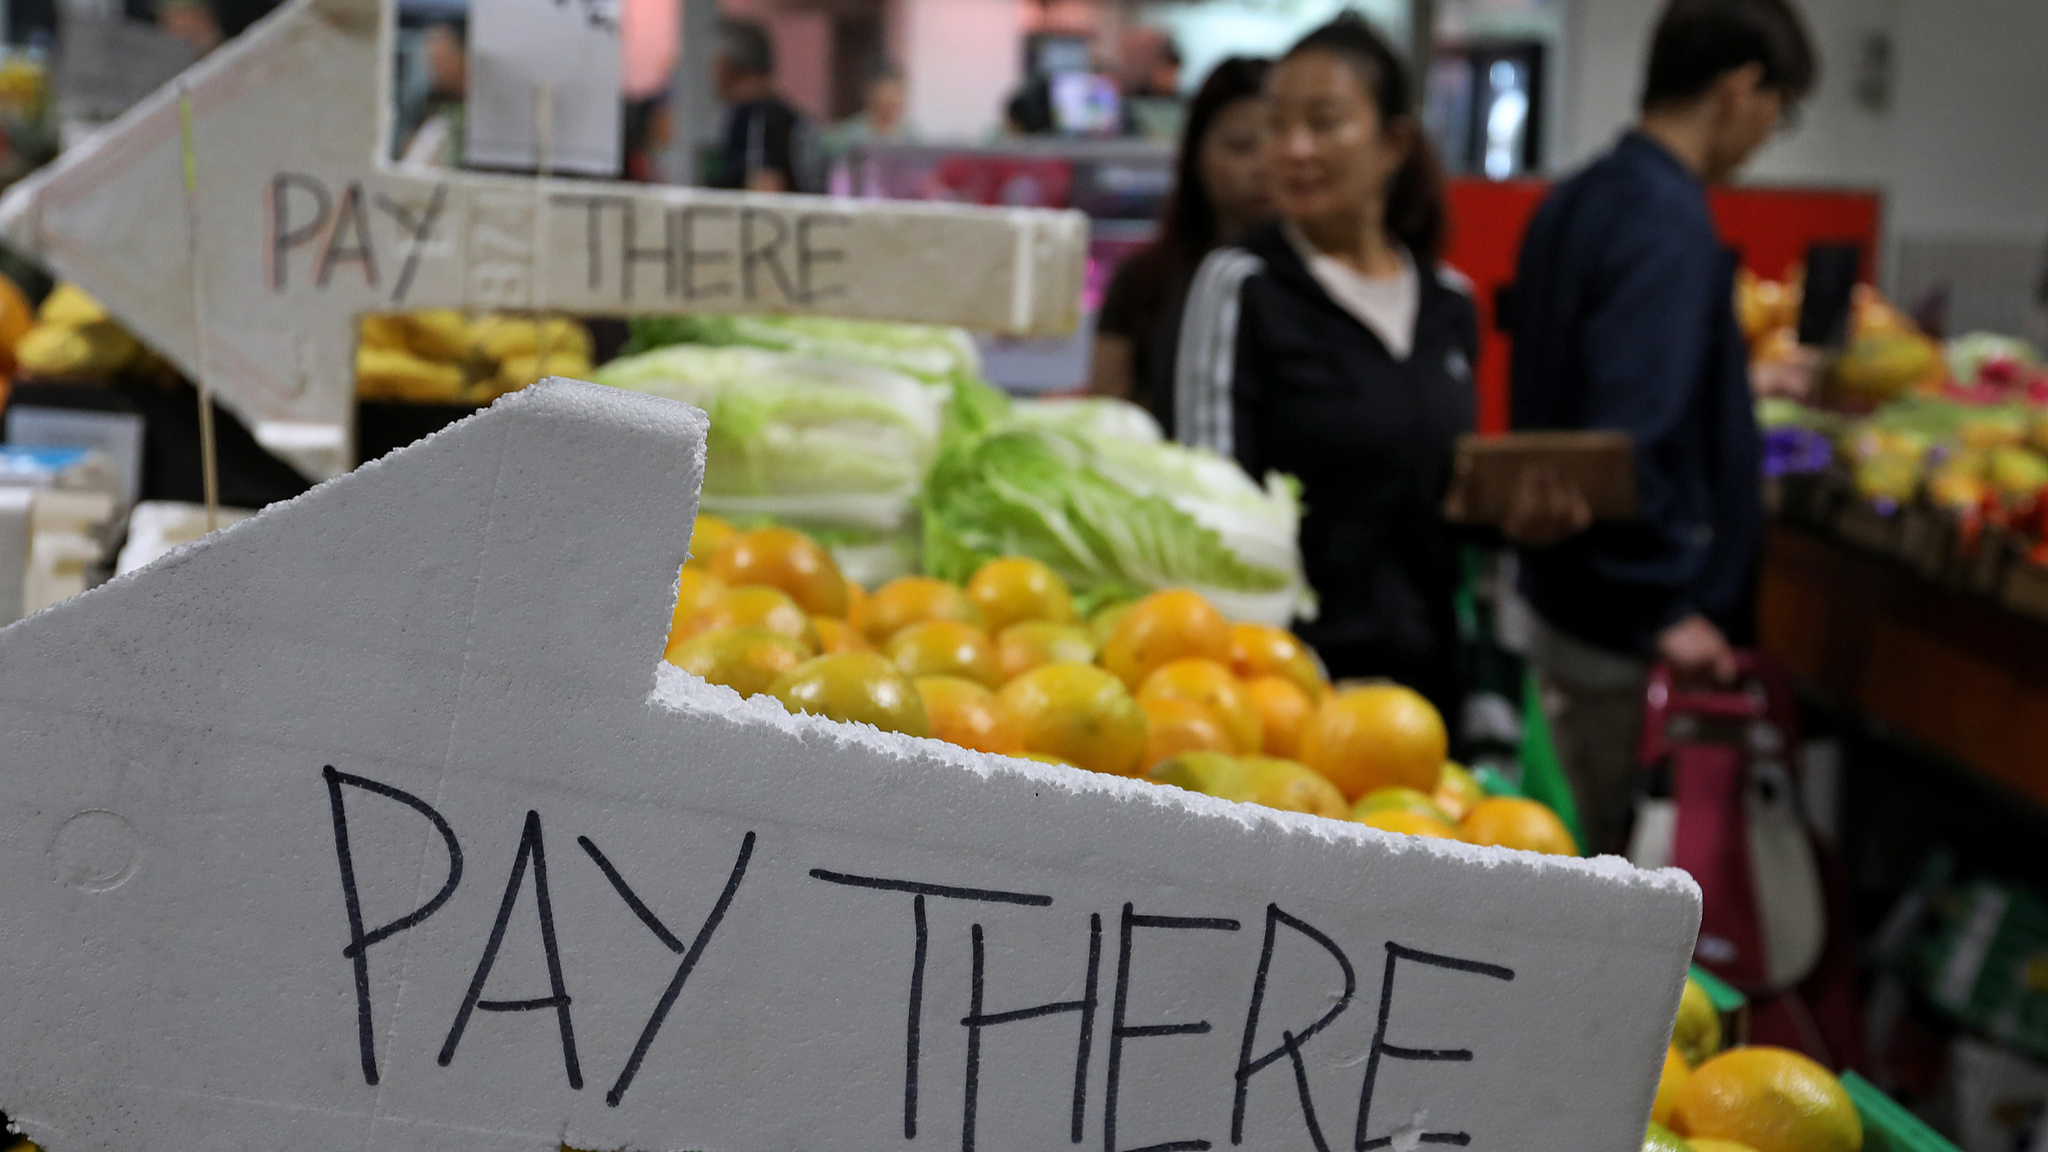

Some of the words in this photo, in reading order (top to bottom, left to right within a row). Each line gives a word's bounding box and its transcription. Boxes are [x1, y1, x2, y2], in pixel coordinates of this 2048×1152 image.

[263, 171, 448, 304] PAY
[549, 193, 850, 304] THERE
[322, 765, 757, 1107] PAY
[809, 868, 1516, 1152] THERE
